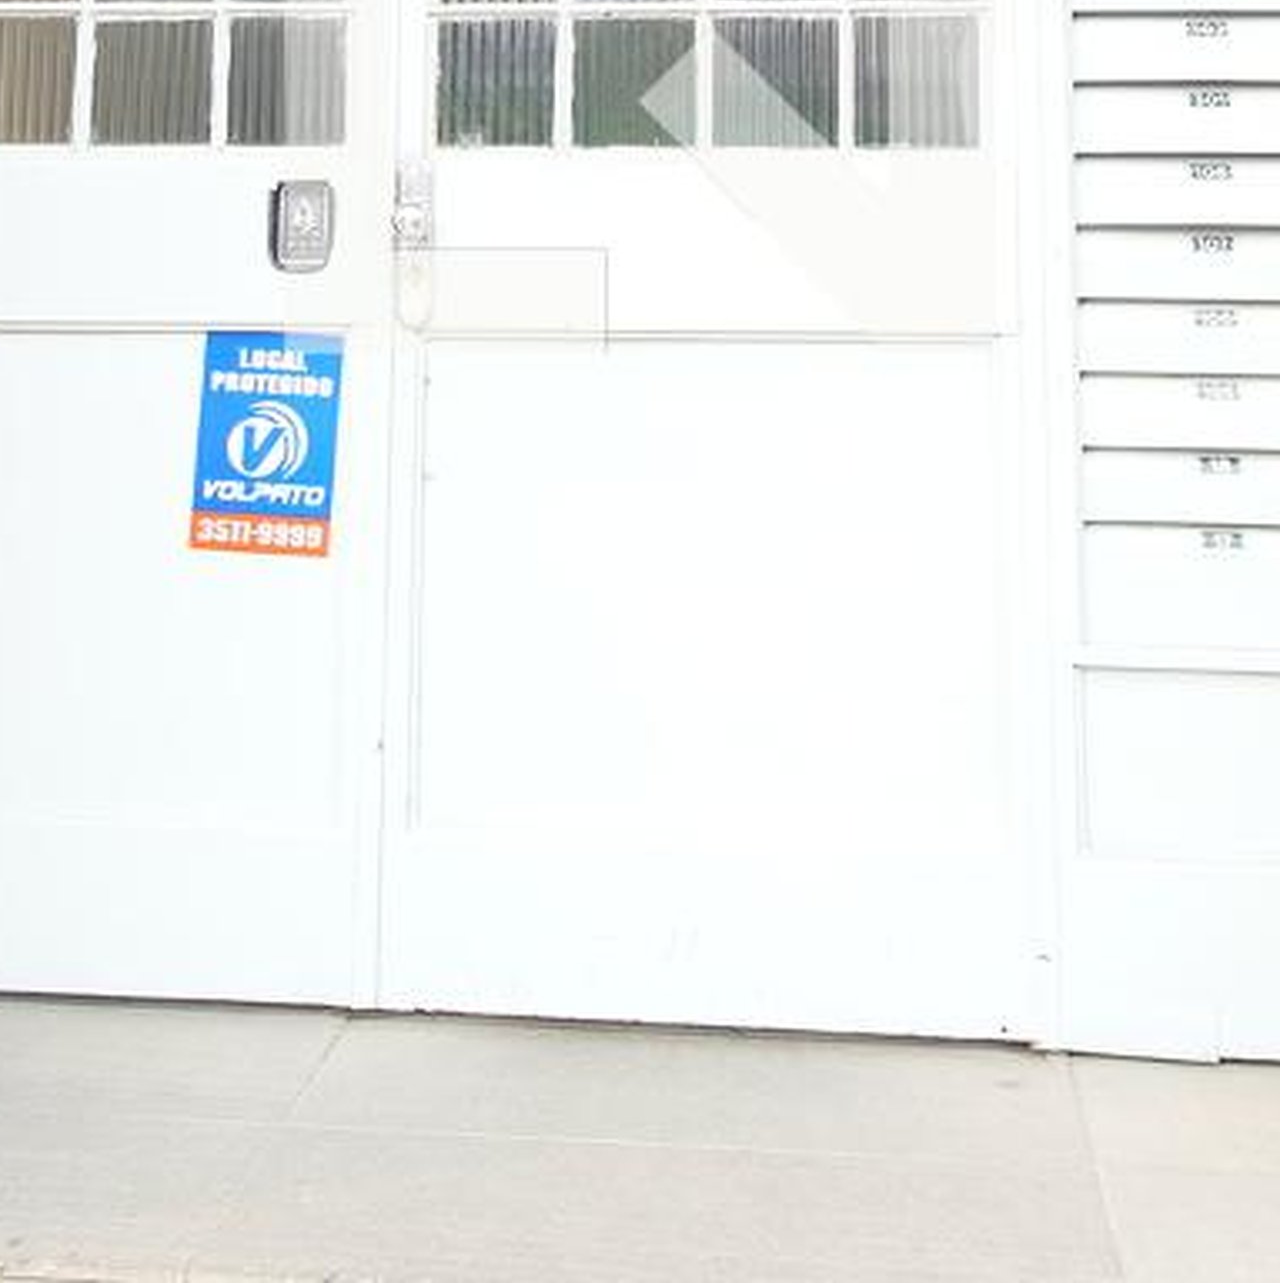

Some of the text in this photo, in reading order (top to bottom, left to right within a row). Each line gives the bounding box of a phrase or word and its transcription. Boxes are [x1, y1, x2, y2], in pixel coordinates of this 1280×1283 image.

[239, 347, 308, 373] LOCAL
[210, 371, 334, 397] PROTEGIDO
[202, 480, 325, 506] VOLPATO
